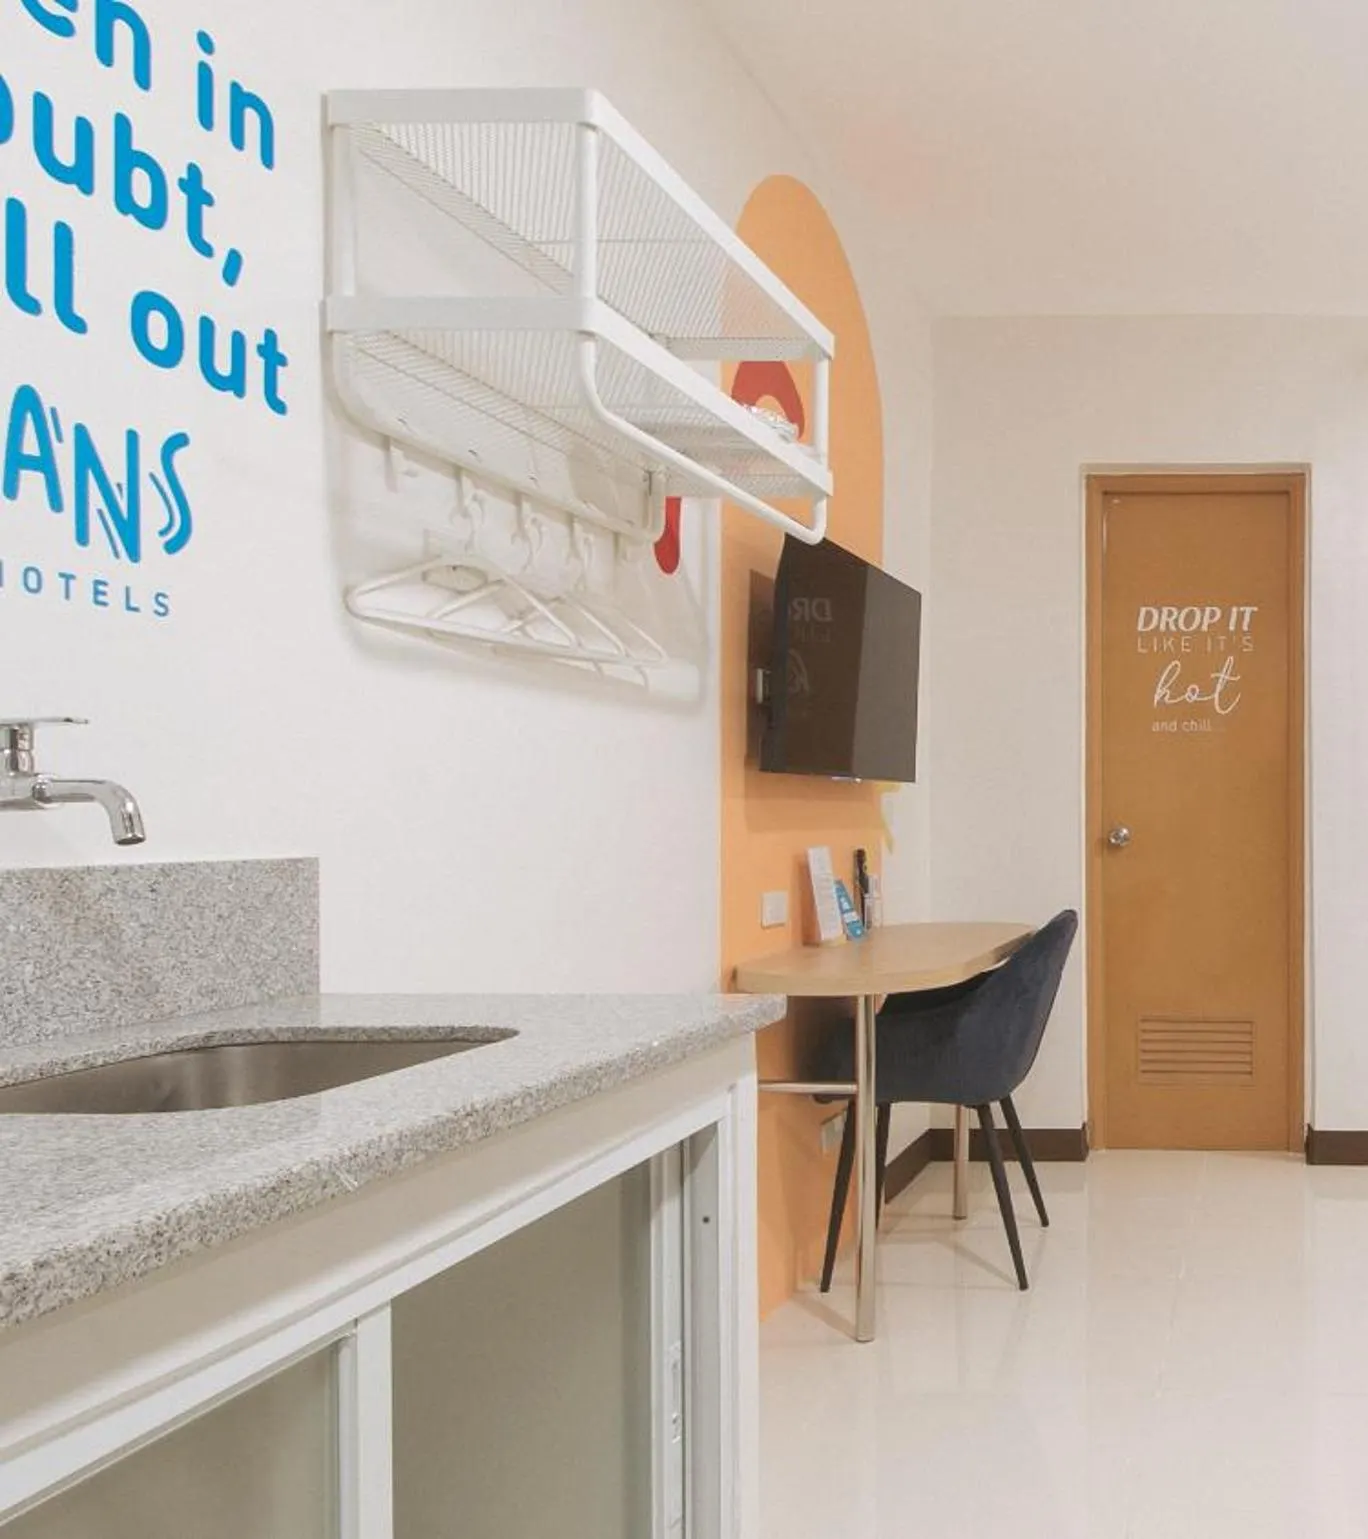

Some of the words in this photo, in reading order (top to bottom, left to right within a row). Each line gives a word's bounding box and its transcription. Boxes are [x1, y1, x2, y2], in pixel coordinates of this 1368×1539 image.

[195, 29, 275, 171] in
[129, 289, 288, 417] out
[0, 559, 170, 618] OTELS
[1137, 606, 1222, 632] DROP
[1228, 606, 1259, 632] IT
[1137, 635, 1193, 653] LIKE
[1206, 635, 1254, 653] IT'S
[1153, 655, 1241, 715] hot
[1152, 719, 1178, 733] and
